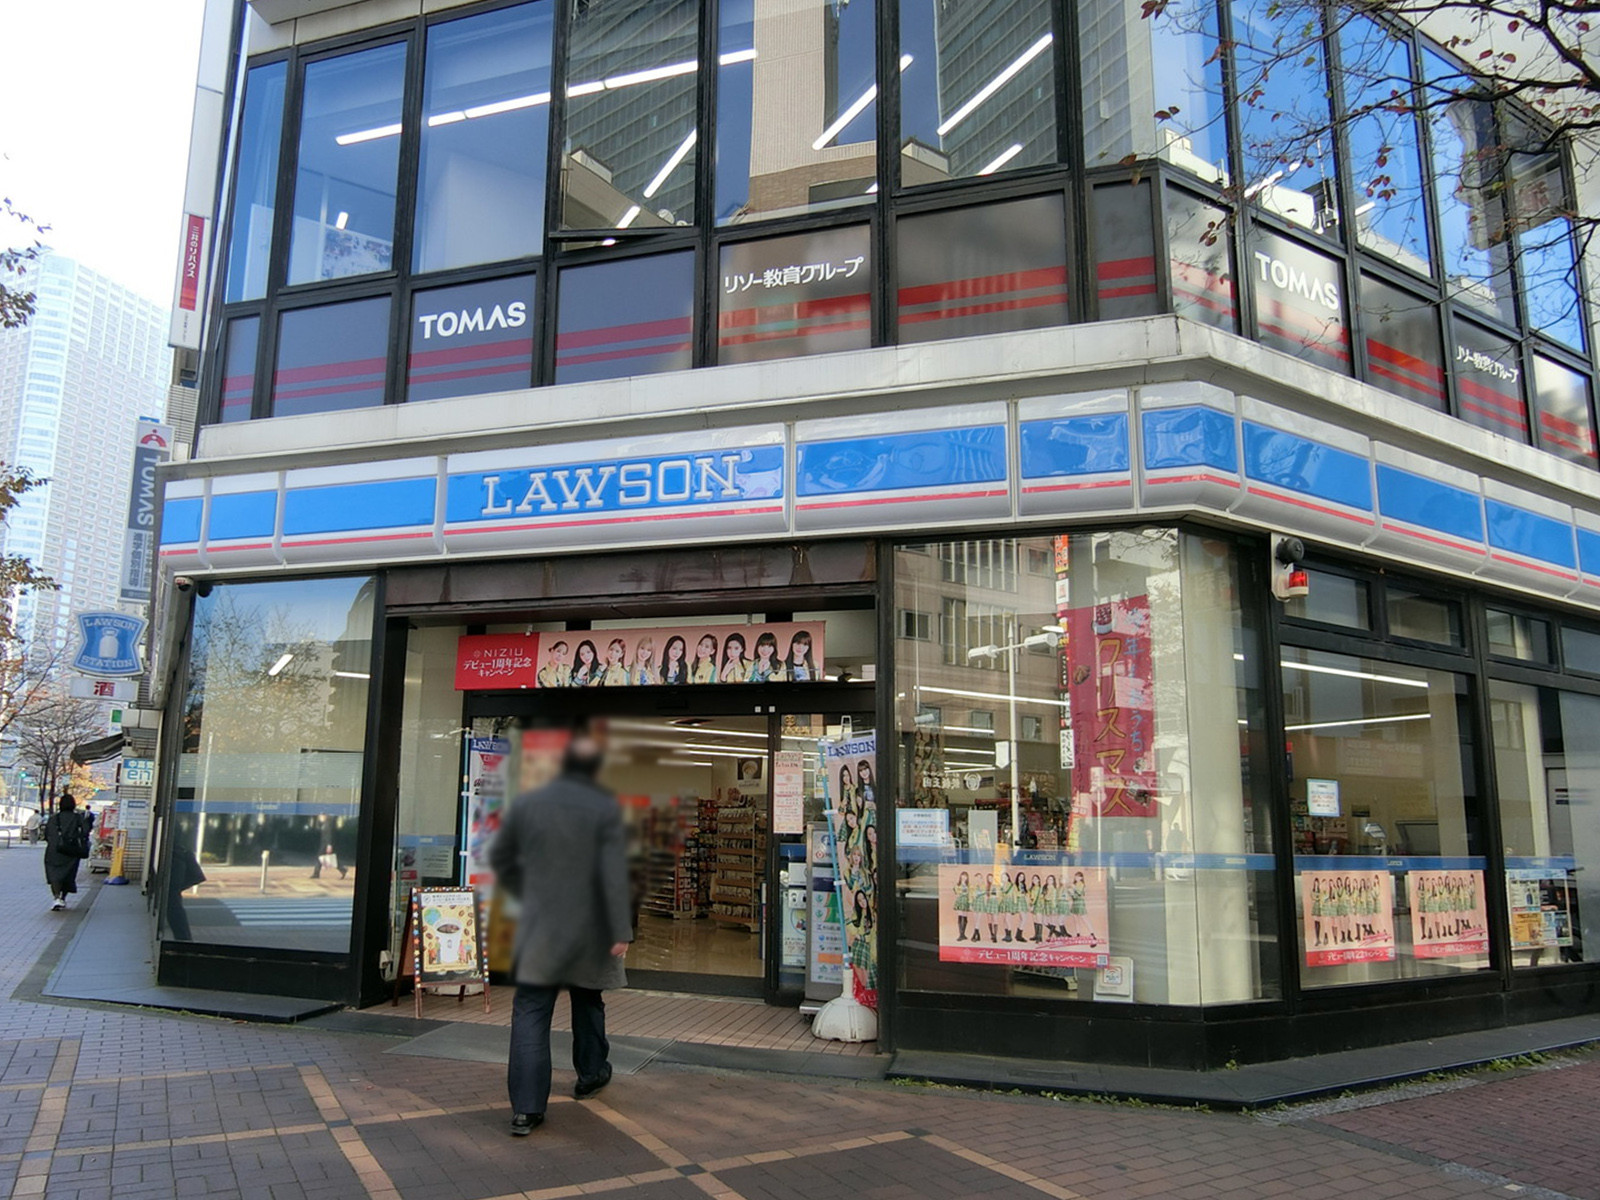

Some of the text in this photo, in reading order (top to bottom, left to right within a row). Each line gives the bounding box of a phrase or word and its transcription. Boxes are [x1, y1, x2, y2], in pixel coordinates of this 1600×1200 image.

[724, 256, 864, 293] リソー教育グループ
[1255, 251, 1339, 310] TOMAS
[419, 302, 526, 339] TOMAS
[137, 455, 161, 526] TOMAS
[481, 454, 741, 517] LAWSON
[85, 619, 137, 632] LAWSON
[484, 648, 523, 658] NIZIU
[82, 655, 133, 668] STATION
[463, 657, 532, 670] デビュー1周年記念
[479, 668, 515, 677] キャンペーン
[94, 681, 115, 697] 酒
[827, 740, 876, 757] LAWSON
